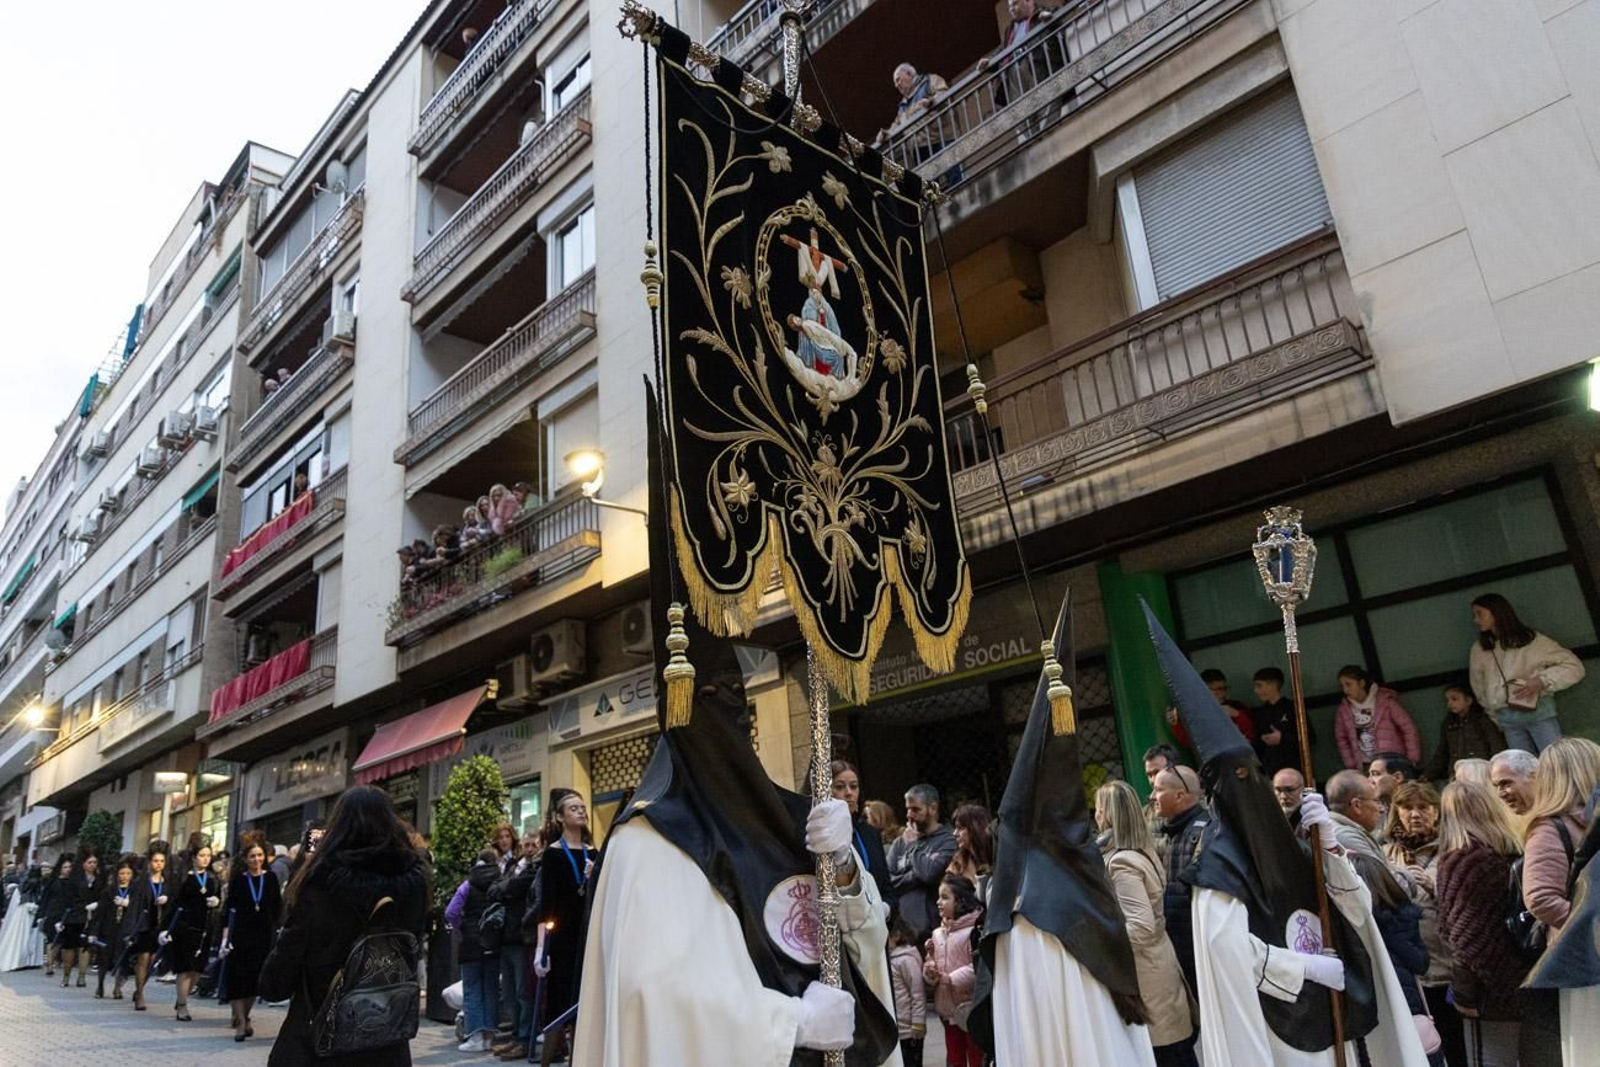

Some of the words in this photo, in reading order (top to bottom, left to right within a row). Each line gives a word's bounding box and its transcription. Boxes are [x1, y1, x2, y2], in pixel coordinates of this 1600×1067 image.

[964, 635, 979, 647] de
[870, 664, 954, 694] SEGURID
[964, 637, 1032, 669] SOCIAL
